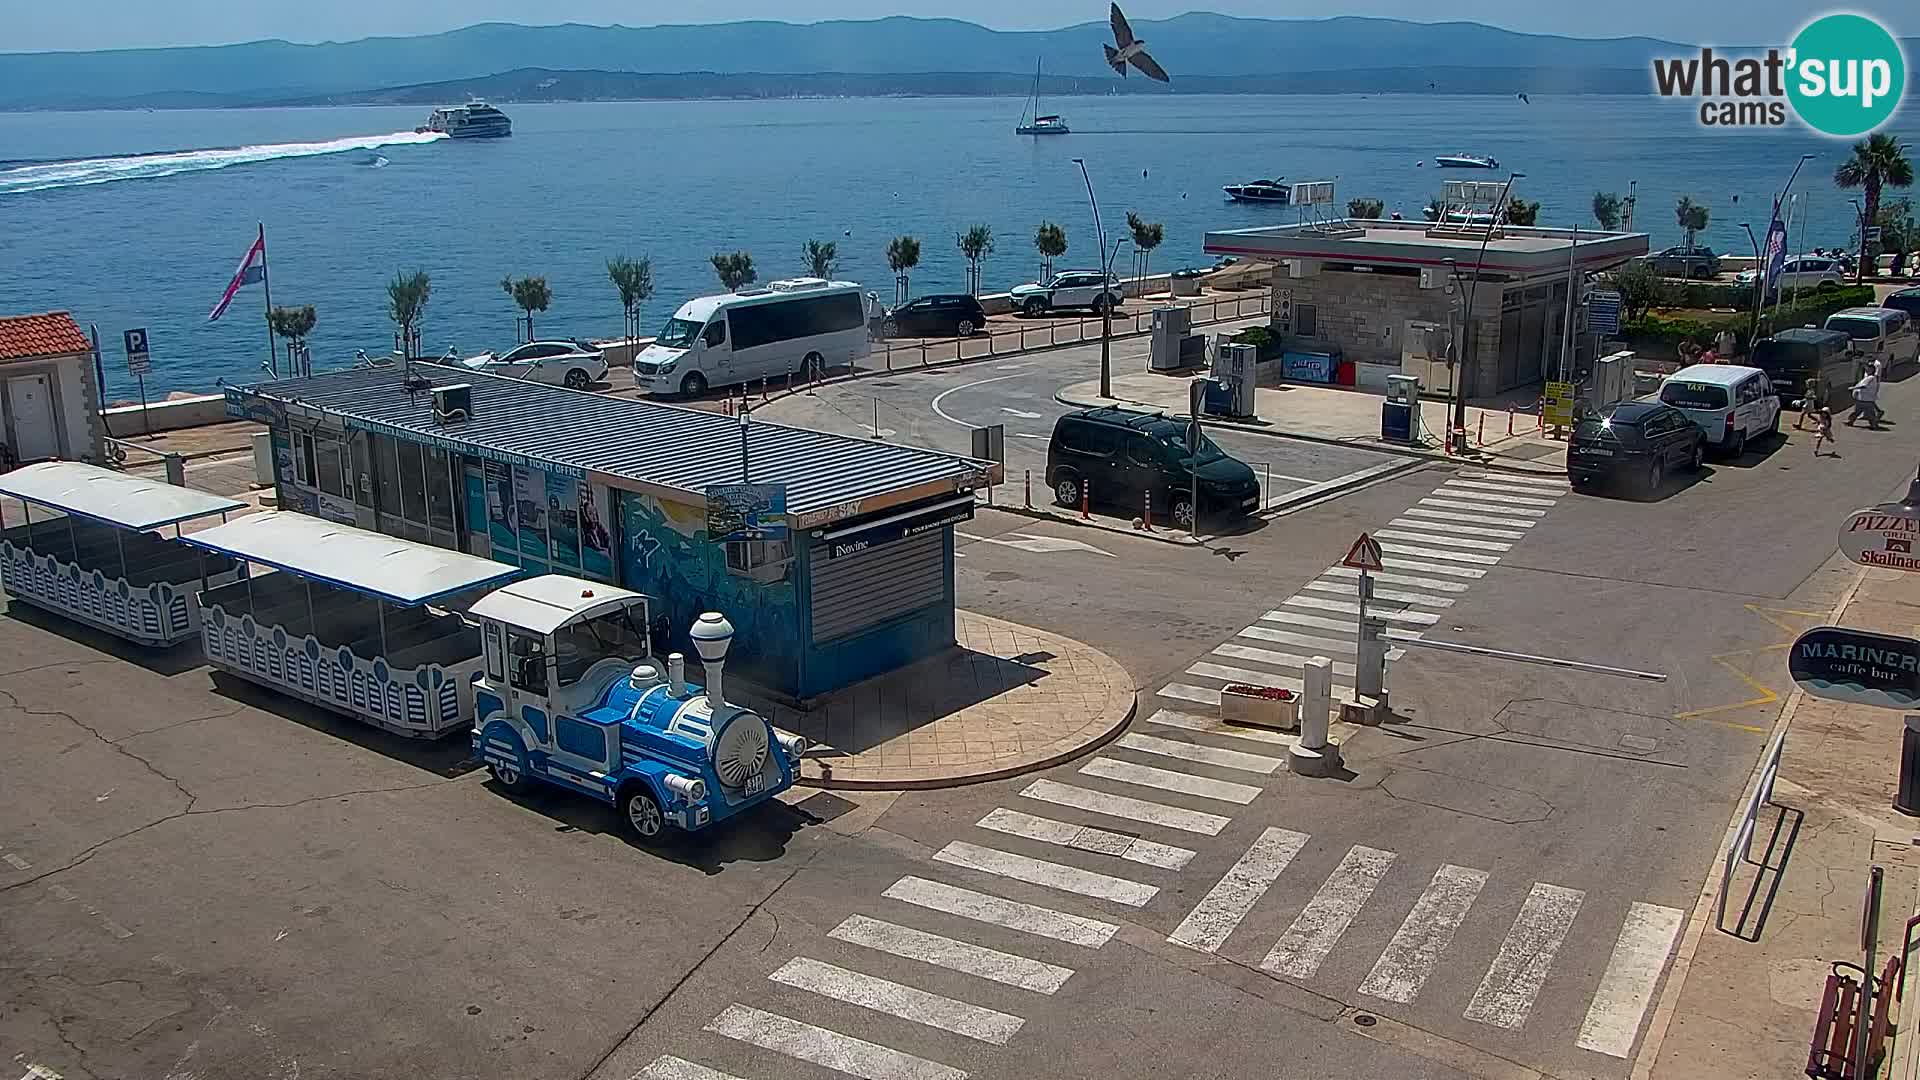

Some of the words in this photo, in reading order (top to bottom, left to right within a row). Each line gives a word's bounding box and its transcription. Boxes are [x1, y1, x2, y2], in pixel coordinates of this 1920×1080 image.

[130, 332, 142, 351] P
[1687, 383, 1706, 392] TAXI
[395, 427, 435, 446] AUTOBUSNA
[436, 437, 468, 452] POSTAJA
[478, 447, 492, 459] BUS
[494, 451, 527, 466] STATION
[528, 459, 554, 473] TICKET
[555, 464, 582, 478] OFFICE
[1847, 515, 1920, 534] PIZZE
[1800, 643, 1920, 673] MARINER
[1829, 662, 1867, 675] caffe
[1871, 666, 1899, 681] bar
